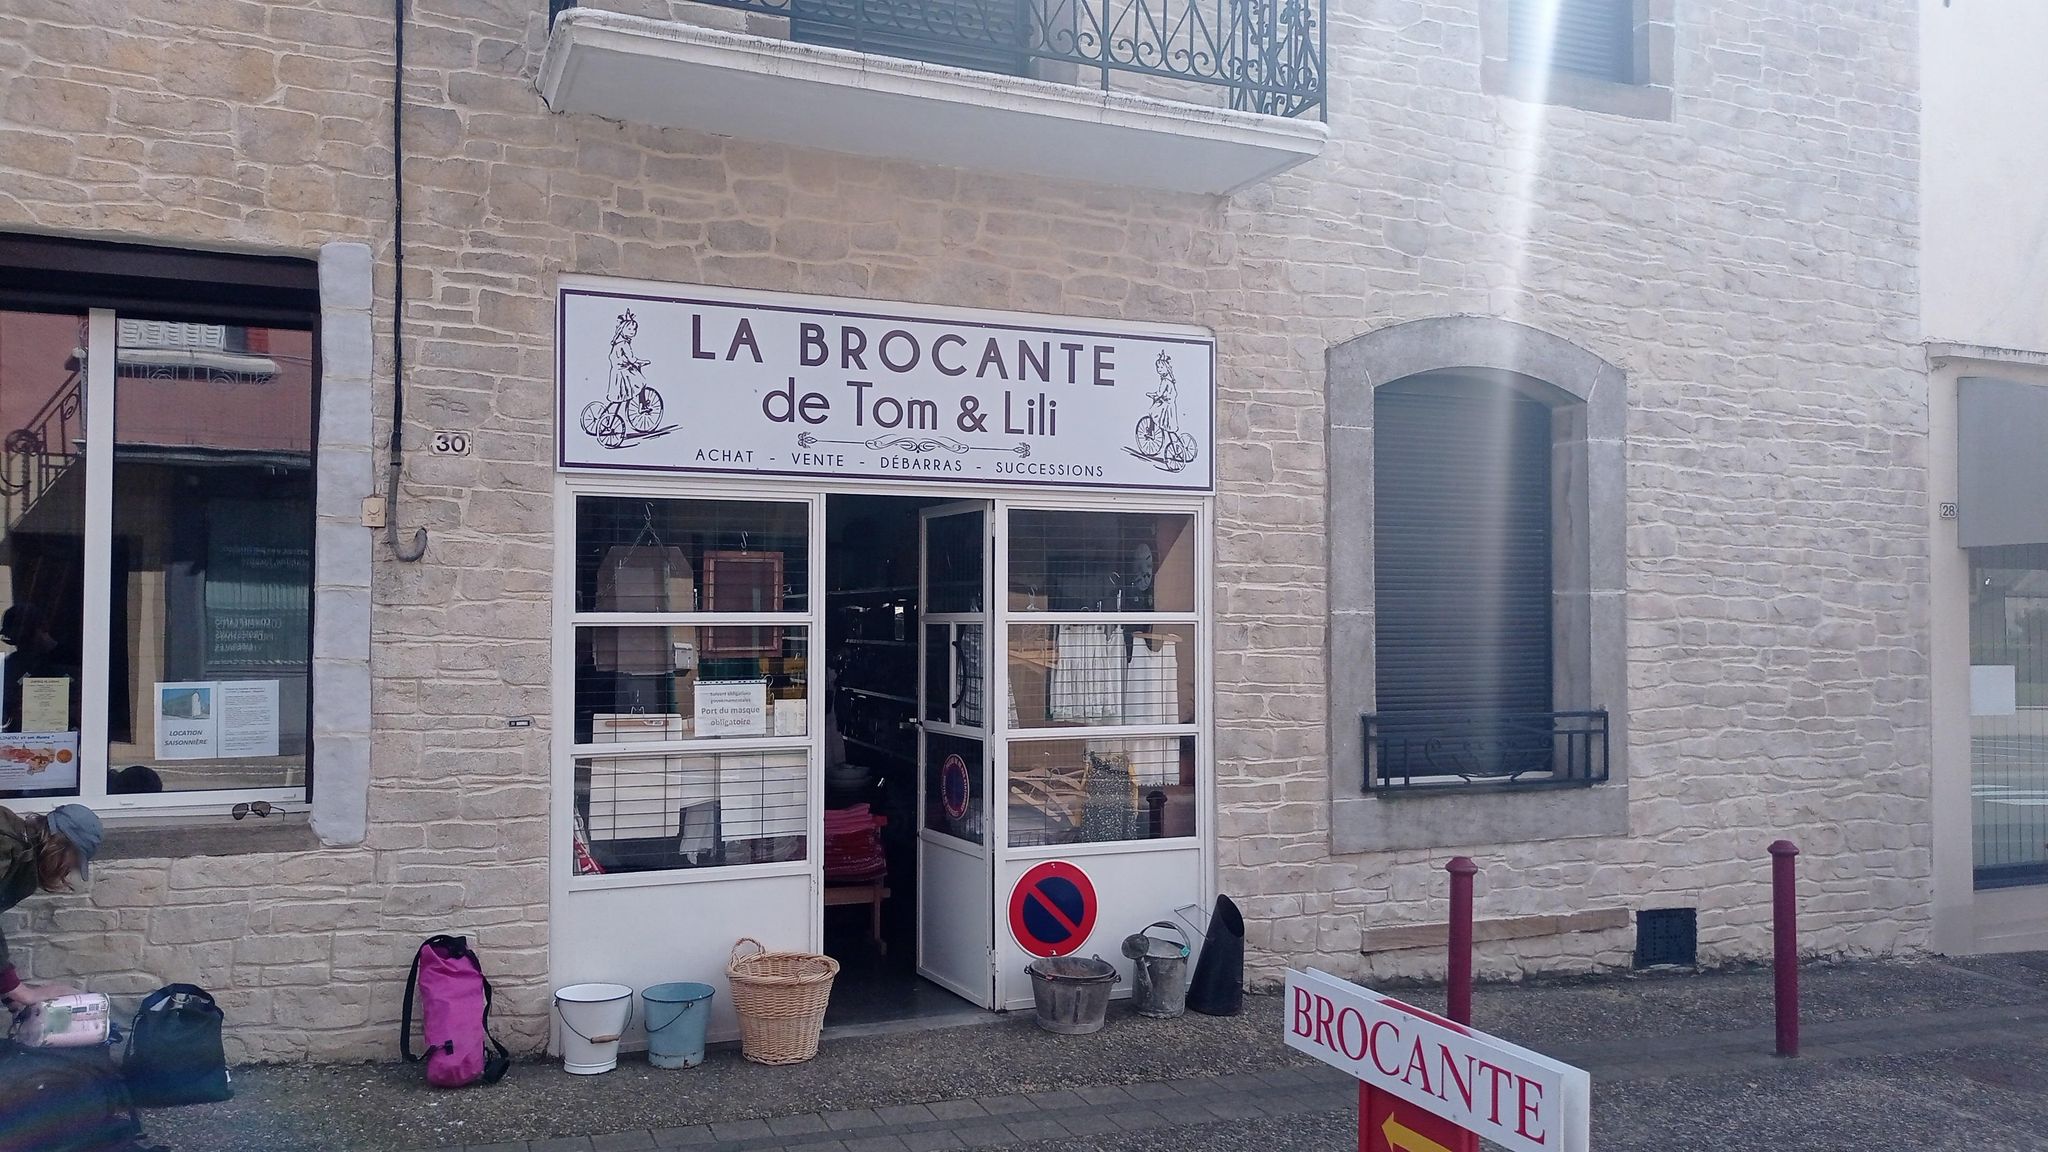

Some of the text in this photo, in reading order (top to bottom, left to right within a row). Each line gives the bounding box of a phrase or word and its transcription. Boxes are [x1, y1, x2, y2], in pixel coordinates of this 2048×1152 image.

[691, 314, 1116, 387] LA BROCANTE
[761, 376, 1057, 437] de Tom & Lili
[436, 434, 466, 453] 30
[695, 448, 754, 463] ACHAT
[791, 452, 844, 467] VENTE
[880, 454, 962, 471] DÉBARRAS
[995, 461, 1104, 477] SUCCESSIONS
[1943, 505, 1955, 516] 28
[701, 706, 760, 715] Port du masque
[710, 717, 751, 727] obligatoire
[164, 738, 208, 746] SAISONNIÈRE
[1291, 984, 1546, 1146] BROCANTE
